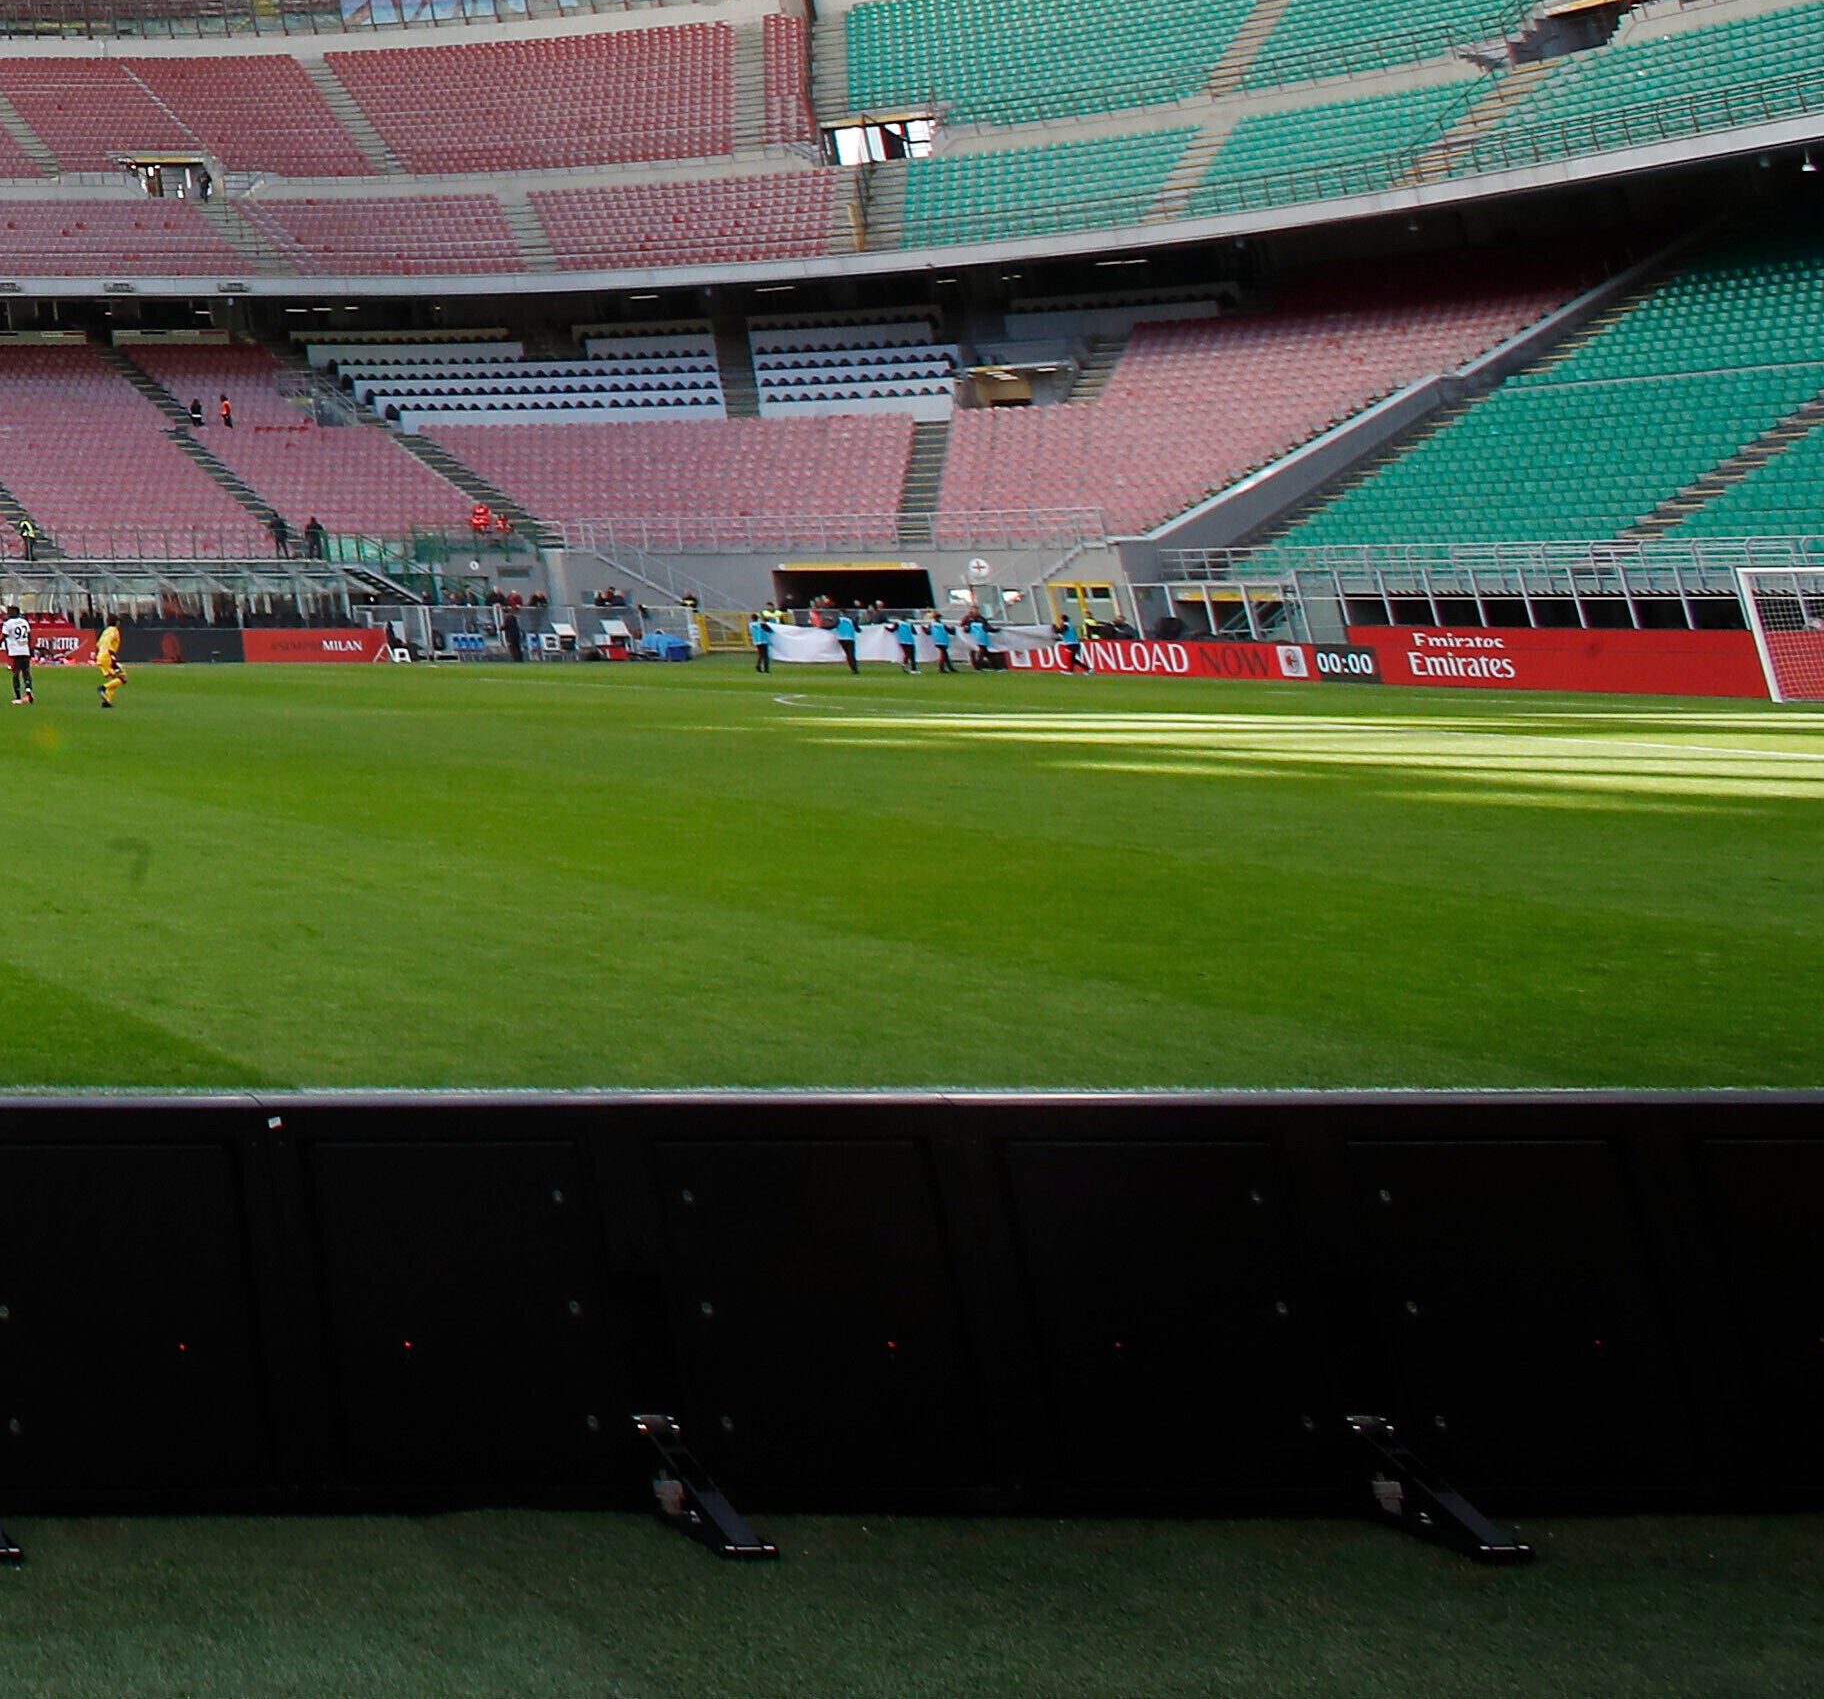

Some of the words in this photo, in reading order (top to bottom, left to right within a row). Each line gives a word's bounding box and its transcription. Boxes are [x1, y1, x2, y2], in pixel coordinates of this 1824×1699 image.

[14, 625, 28, 640] 92
[52, 636, 80, 650] BETTER
[1199, 645, 1272, 677] NOW
[1315, 651, 1373, 675] 00:00
[1406, 651, 1516, 679] Emirates
